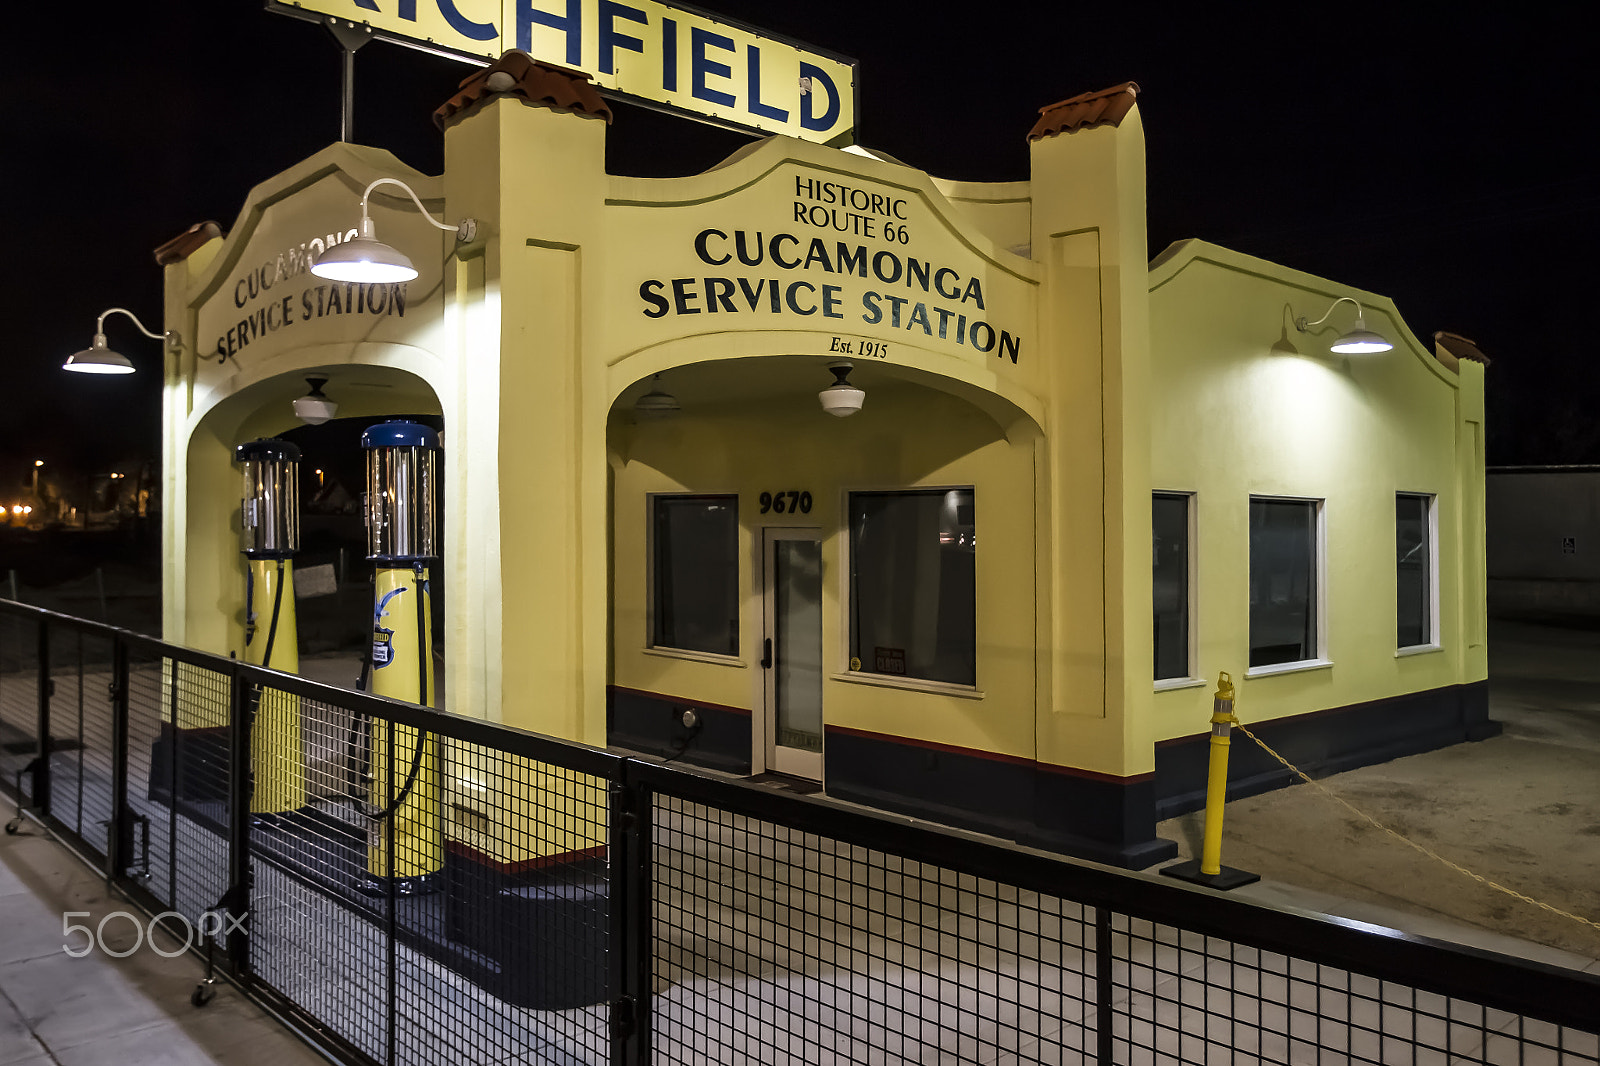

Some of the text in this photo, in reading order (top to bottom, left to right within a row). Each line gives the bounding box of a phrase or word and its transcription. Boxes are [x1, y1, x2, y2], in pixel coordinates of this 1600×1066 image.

[353, 0, 841, 133] CHFIELD
[792, 200, 910, 246] ROUTE 66
[795, 174, 908, 221] HISTORIC
[234, 228, 359, 309] CUCAMO
[694, 227, 985, 311] CUCAMONGA
[216, 281, 408, 365] SERVICE STATION
[639, 276, 1021, 365] SERVICE STATION
[828, 336, 889, 360] Est. 1915
[758, 490, 813, 515] 9670
